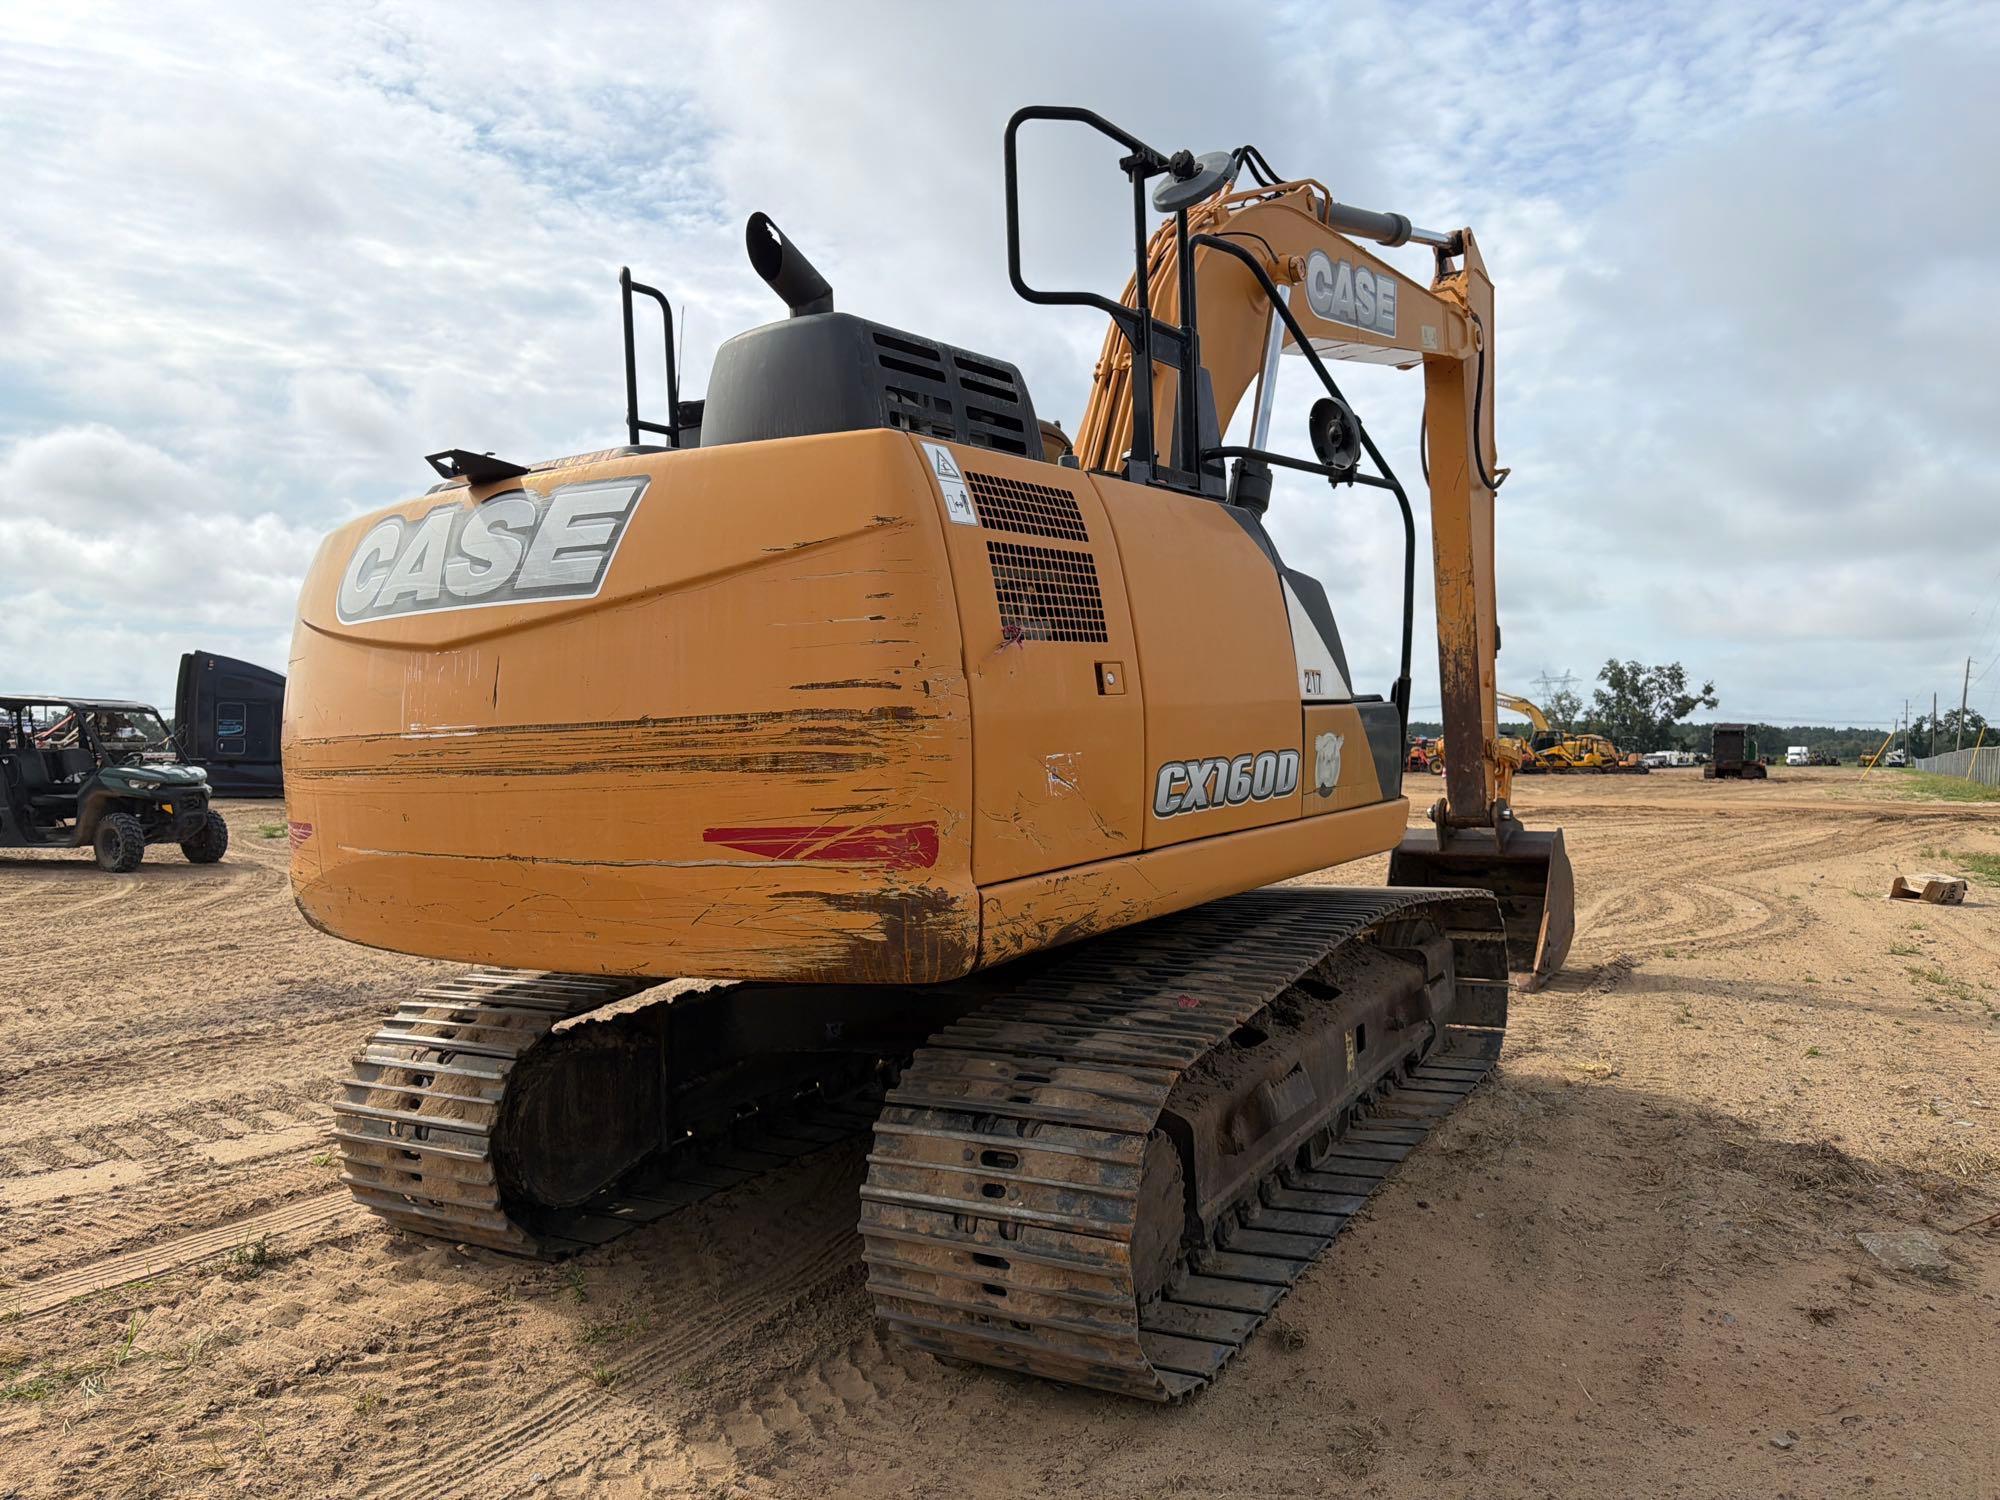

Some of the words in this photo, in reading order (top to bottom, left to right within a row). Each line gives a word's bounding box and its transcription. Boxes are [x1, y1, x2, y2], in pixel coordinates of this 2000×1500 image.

[1307, 252, 1396, 330] CASE
[340, 485, 638, 615] CASE
[1154, 749, 1300, 819] CX160D
